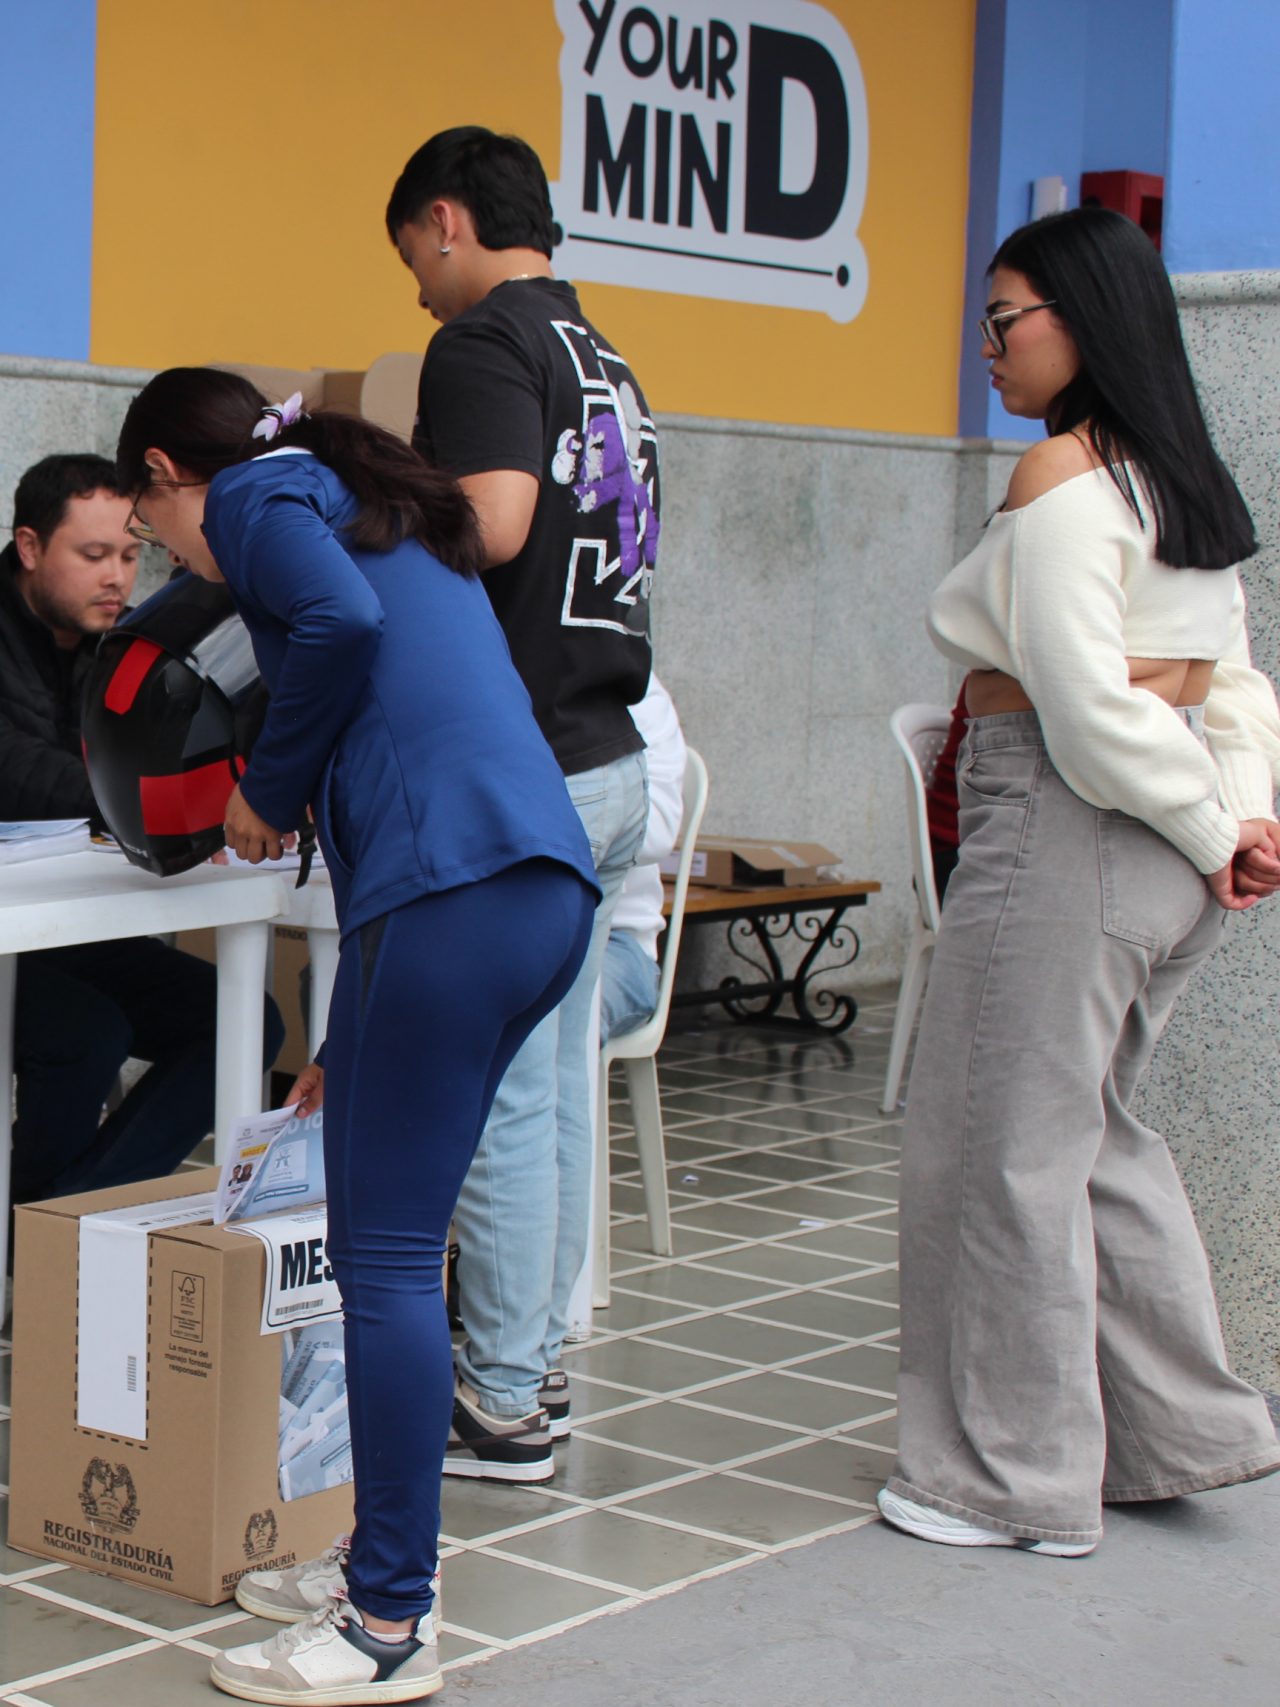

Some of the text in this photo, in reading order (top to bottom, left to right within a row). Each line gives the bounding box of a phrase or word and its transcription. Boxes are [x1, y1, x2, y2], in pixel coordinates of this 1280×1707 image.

[578, 0, 738, 101] YOUR
[582, 23, 850, 242] MIND
[42, 1535, 175, 1582] NACIONAL DEL ESTADO CIVIL
[43, 1519, 174, 1571] REGISTRADURÍA
